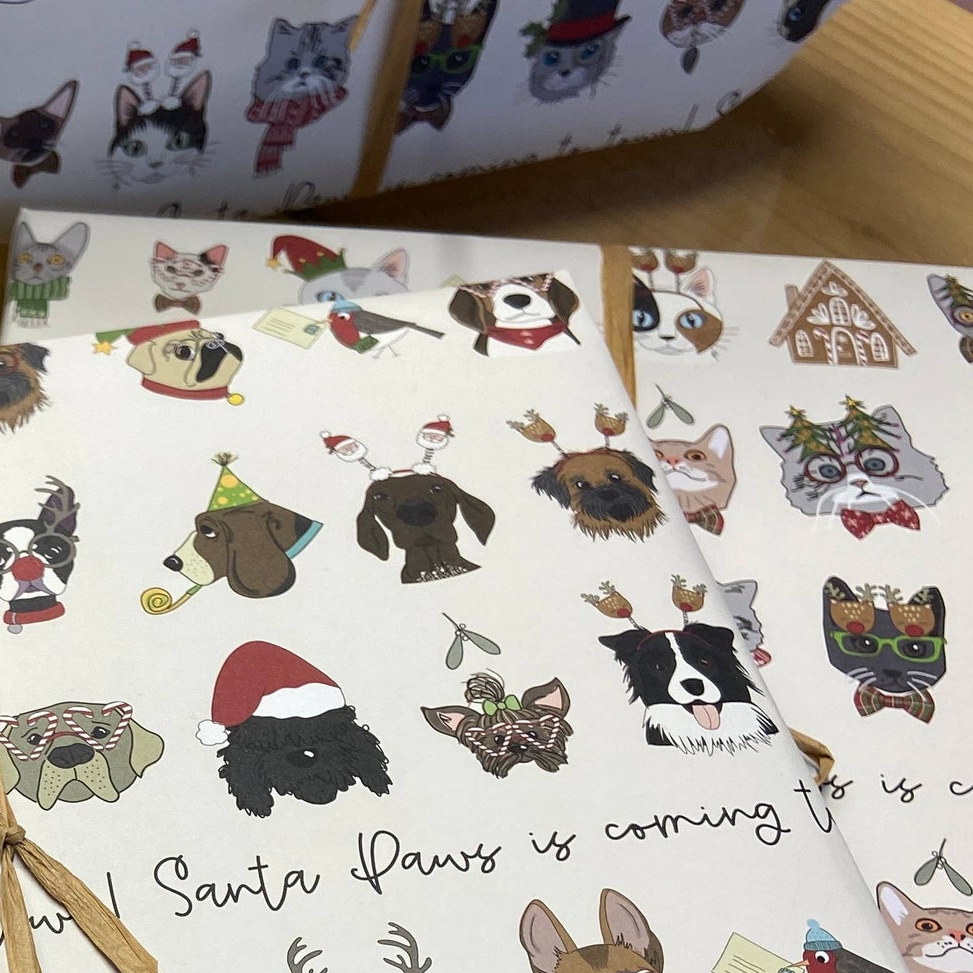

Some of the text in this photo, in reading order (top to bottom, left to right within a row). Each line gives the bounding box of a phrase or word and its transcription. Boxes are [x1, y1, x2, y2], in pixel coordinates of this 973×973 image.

[879, 773, 923, 803] is
[153, 854, 321, 918] Santa
[349, 829, 503, 895] Paws
[528, 830, 577, 862] is
[604, 801, 792, 846] coming
